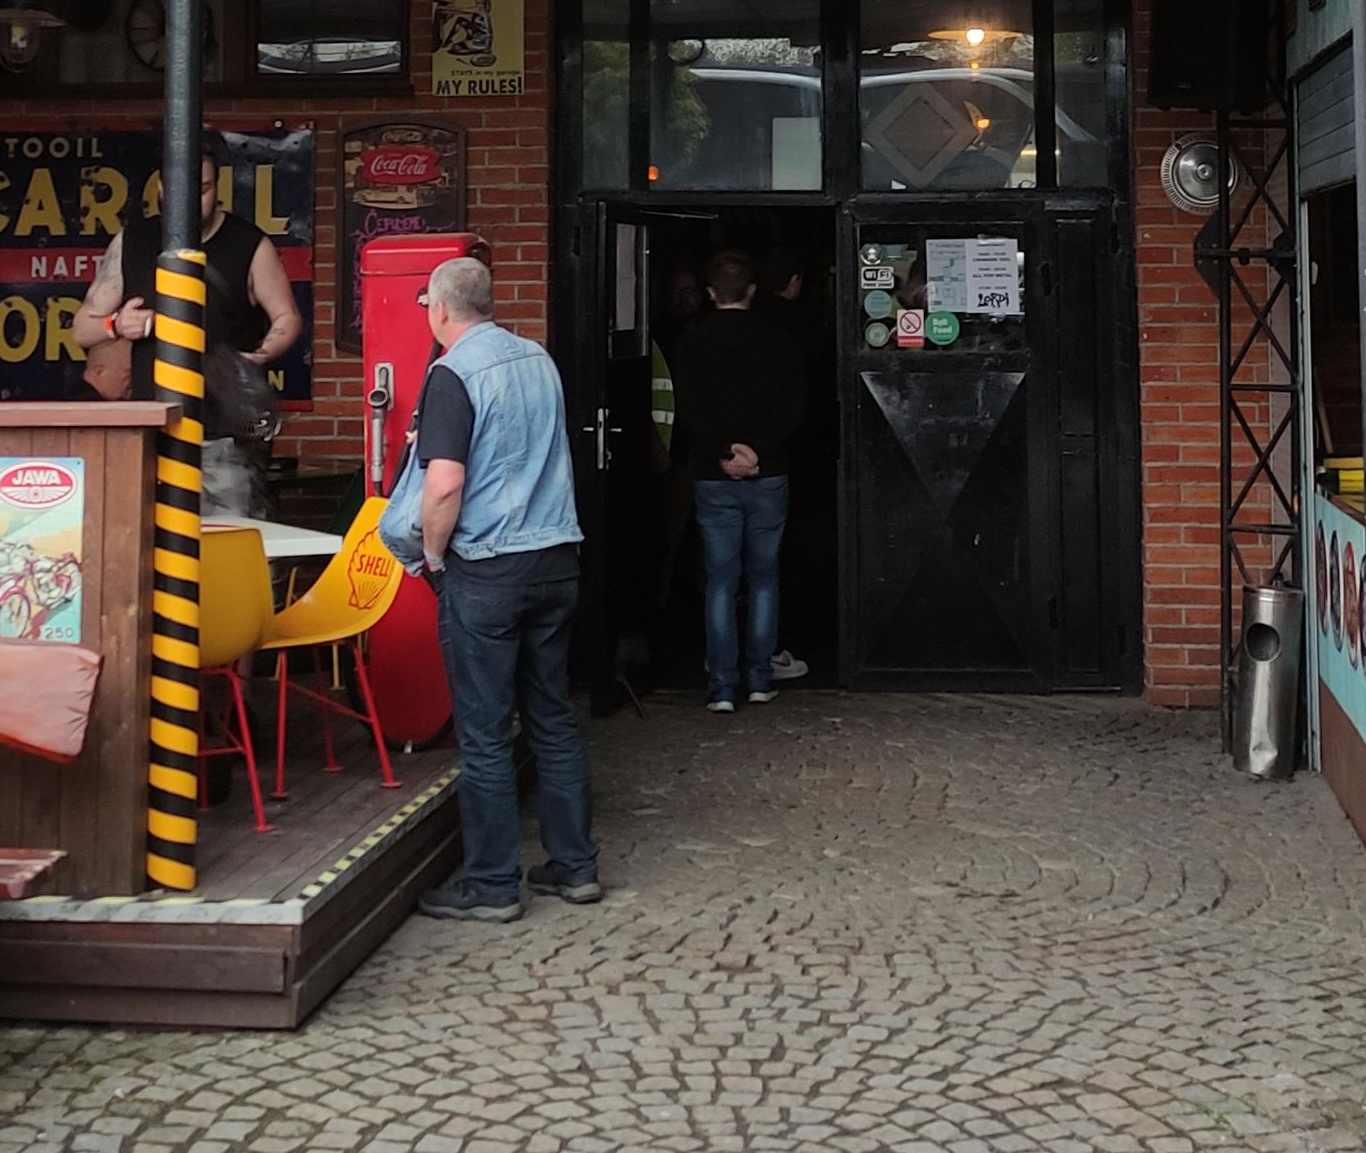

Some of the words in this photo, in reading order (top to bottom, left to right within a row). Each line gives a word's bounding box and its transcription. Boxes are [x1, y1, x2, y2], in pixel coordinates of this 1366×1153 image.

[436, 79, 462, 95] MY
[468, 76, 522, 95] RULES!
[12, 469, 61, 486] JAWA
[356, 553, 392, 578] SHELL
[45, 626, 75, 639] 250
